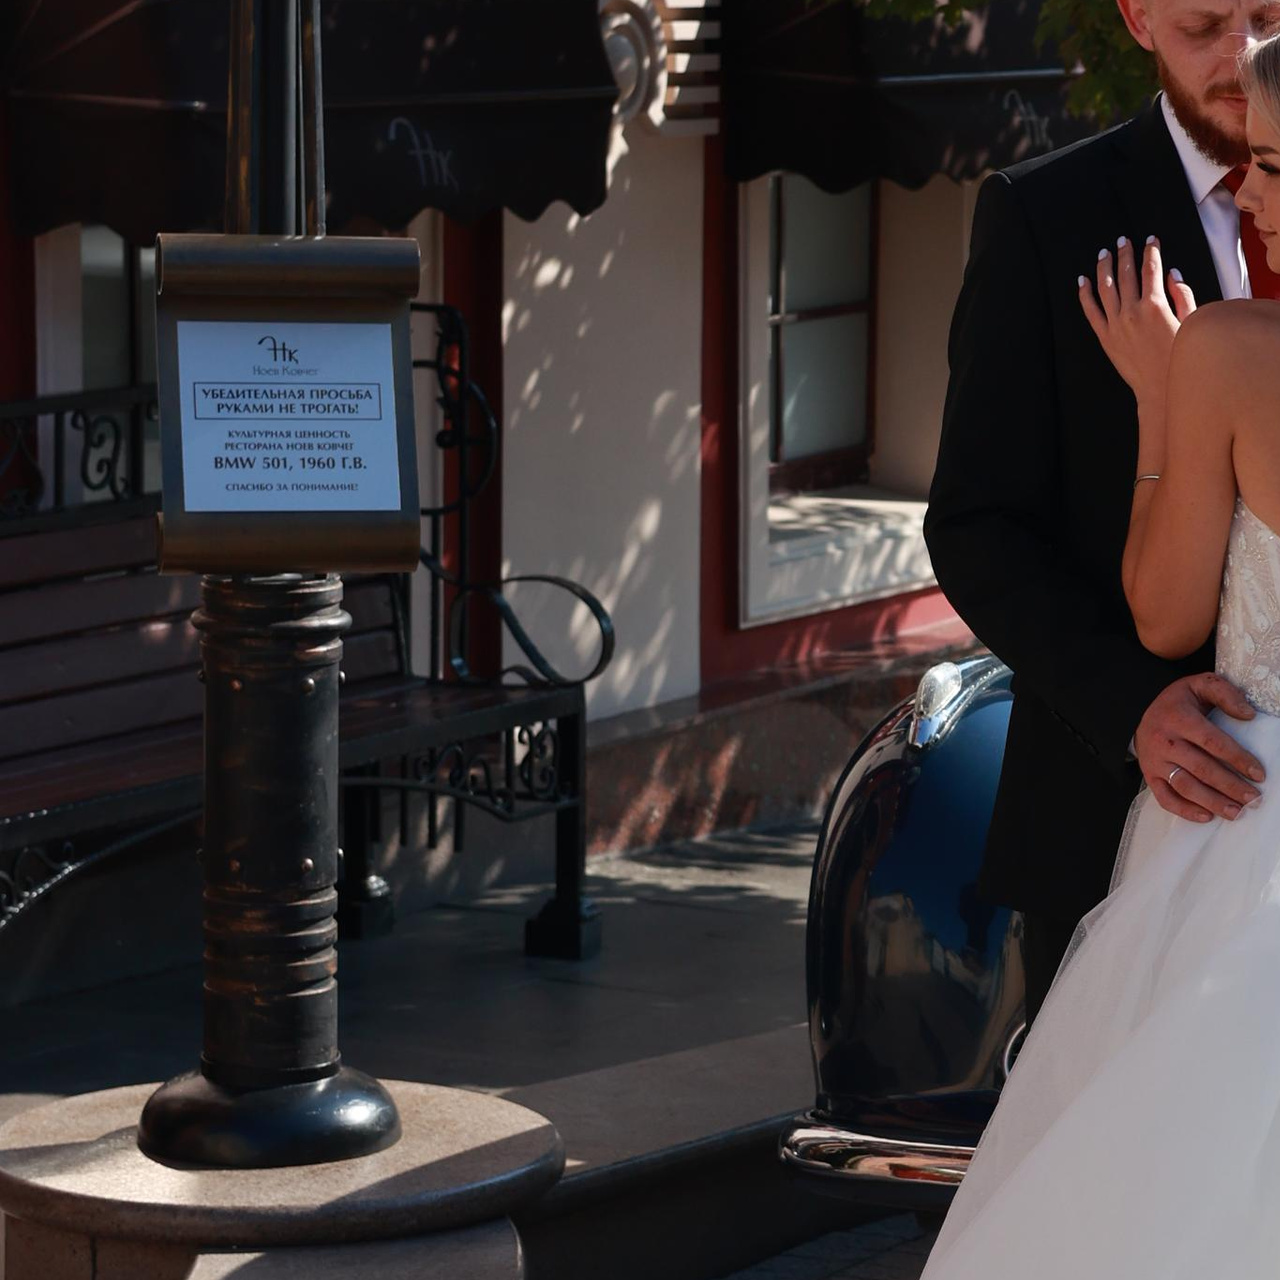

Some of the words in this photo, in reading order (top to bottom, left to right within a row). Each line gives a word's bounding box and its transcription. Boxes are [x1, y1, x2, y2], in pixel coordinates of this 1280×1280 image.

[202, 388, 305, 400] УБЕДИТЕЛЬНАЯ
[310, 389, 373, 400] ПРОСЬБА
[217, 403, 274, 414] РУКАМИ
[279, 403, 296, 414] НЕ
[300, 403, 359, 414] ТРОГАТЬ!
[227, 430, 292, 439] КУЛЬТУРНАЯ
[294, 430, 351, 439] ЦЕННОСТЬ
[224, 442, 283, 451] РЕСТОРАНА
[286, 442, 314, 451] НОЕВ
[317, 442, 354, 451] КОВЧЕГ
[214, 456, 256, 469] BMW
[262, 456, 293, 471] 501,
[300, 456, 336, 469] 1960
[341, 456, 367, 469] Г.В.
[225, 483, 273, 491] СПАСИБО
[276, 483, 288, 491] ЗА
[291, 483, 359, 491] ПОНИМАНИЕ!
